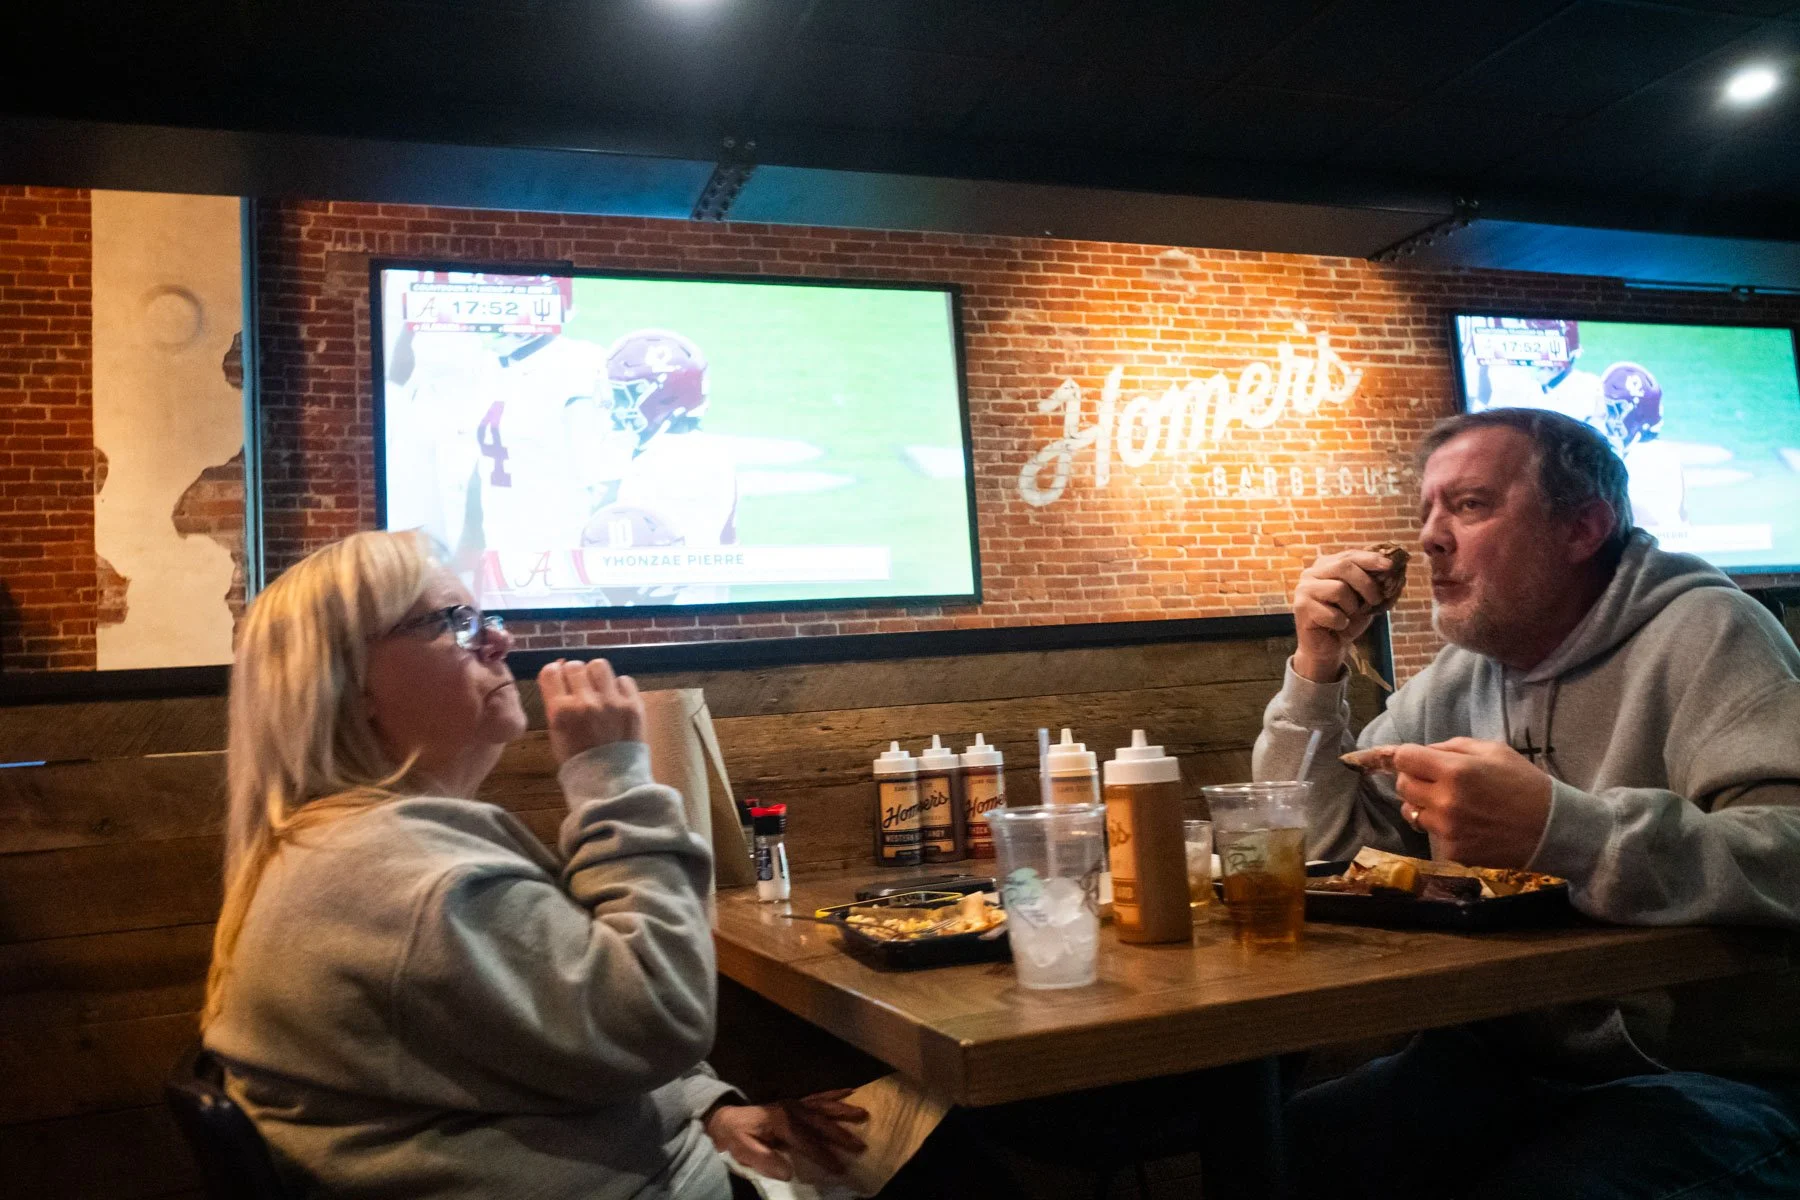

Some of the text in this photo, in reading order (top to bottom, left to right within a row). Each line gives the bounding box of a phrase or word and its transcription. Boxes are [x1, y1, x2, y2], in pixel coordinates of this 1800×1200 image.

[452, 301, 519, 316] 17:52
[1501, 341, 1541, 353] 17:52
[1018, 320, 1363, 508] Homer's
[602, 553, 745, 567] YHONZAE PIERRE
